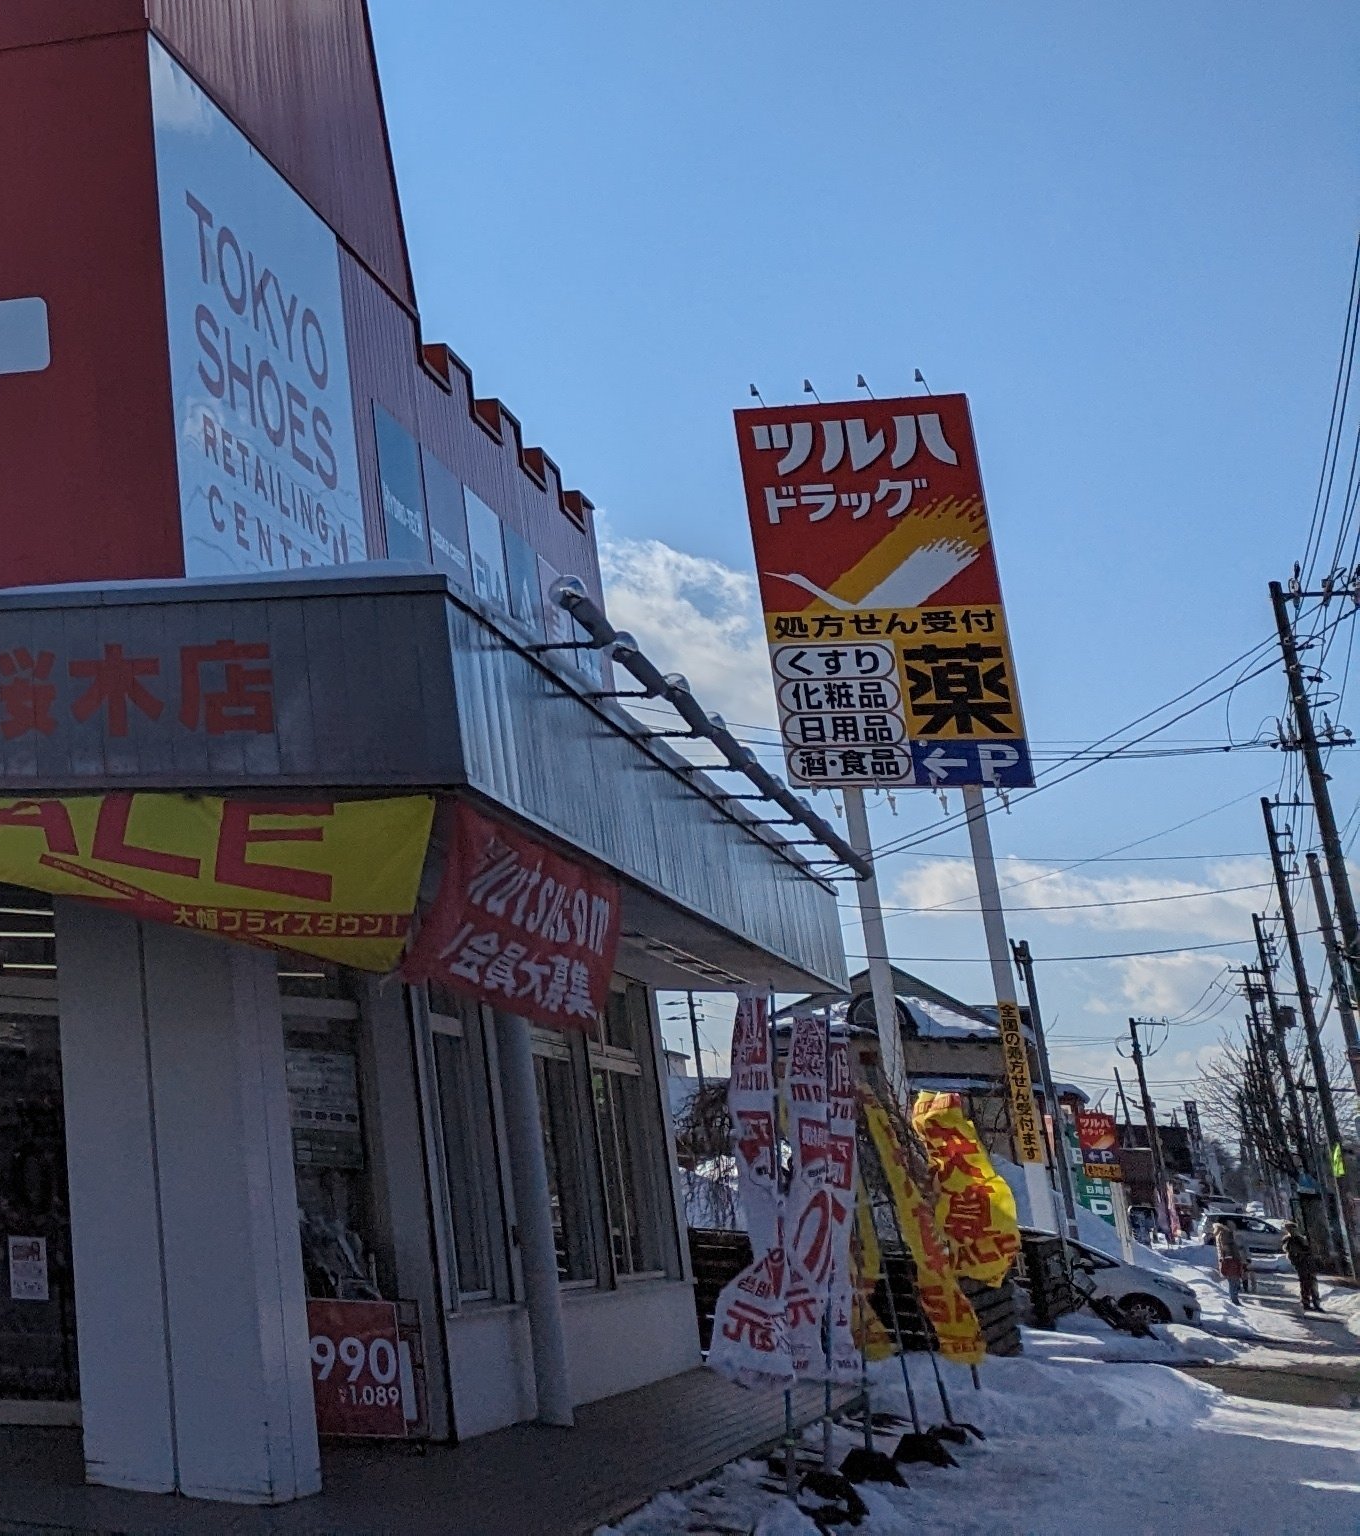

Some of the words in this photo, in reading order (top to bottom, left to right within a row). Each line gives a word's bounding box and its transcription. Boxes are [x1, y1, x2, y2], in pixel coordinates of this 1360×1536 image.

[185, 190, 329, 391] TOKYO
[195, 304, 339, 491] SHOES
[751, 413, 958, 477] ツルハ
[202, 413, 330, 545] RETAILING
[764, 477, 928, 524] ドラッグ
[774, 608, 997, 639] 処方せん受付
[788, 649, 880, 676] くすり
[791, 681, 887, 711] 化粧品
[903, 642, 1016, 736] 薬
[798, 714, 893, 745] 日用品
[977, 744, 1020, 782] P
